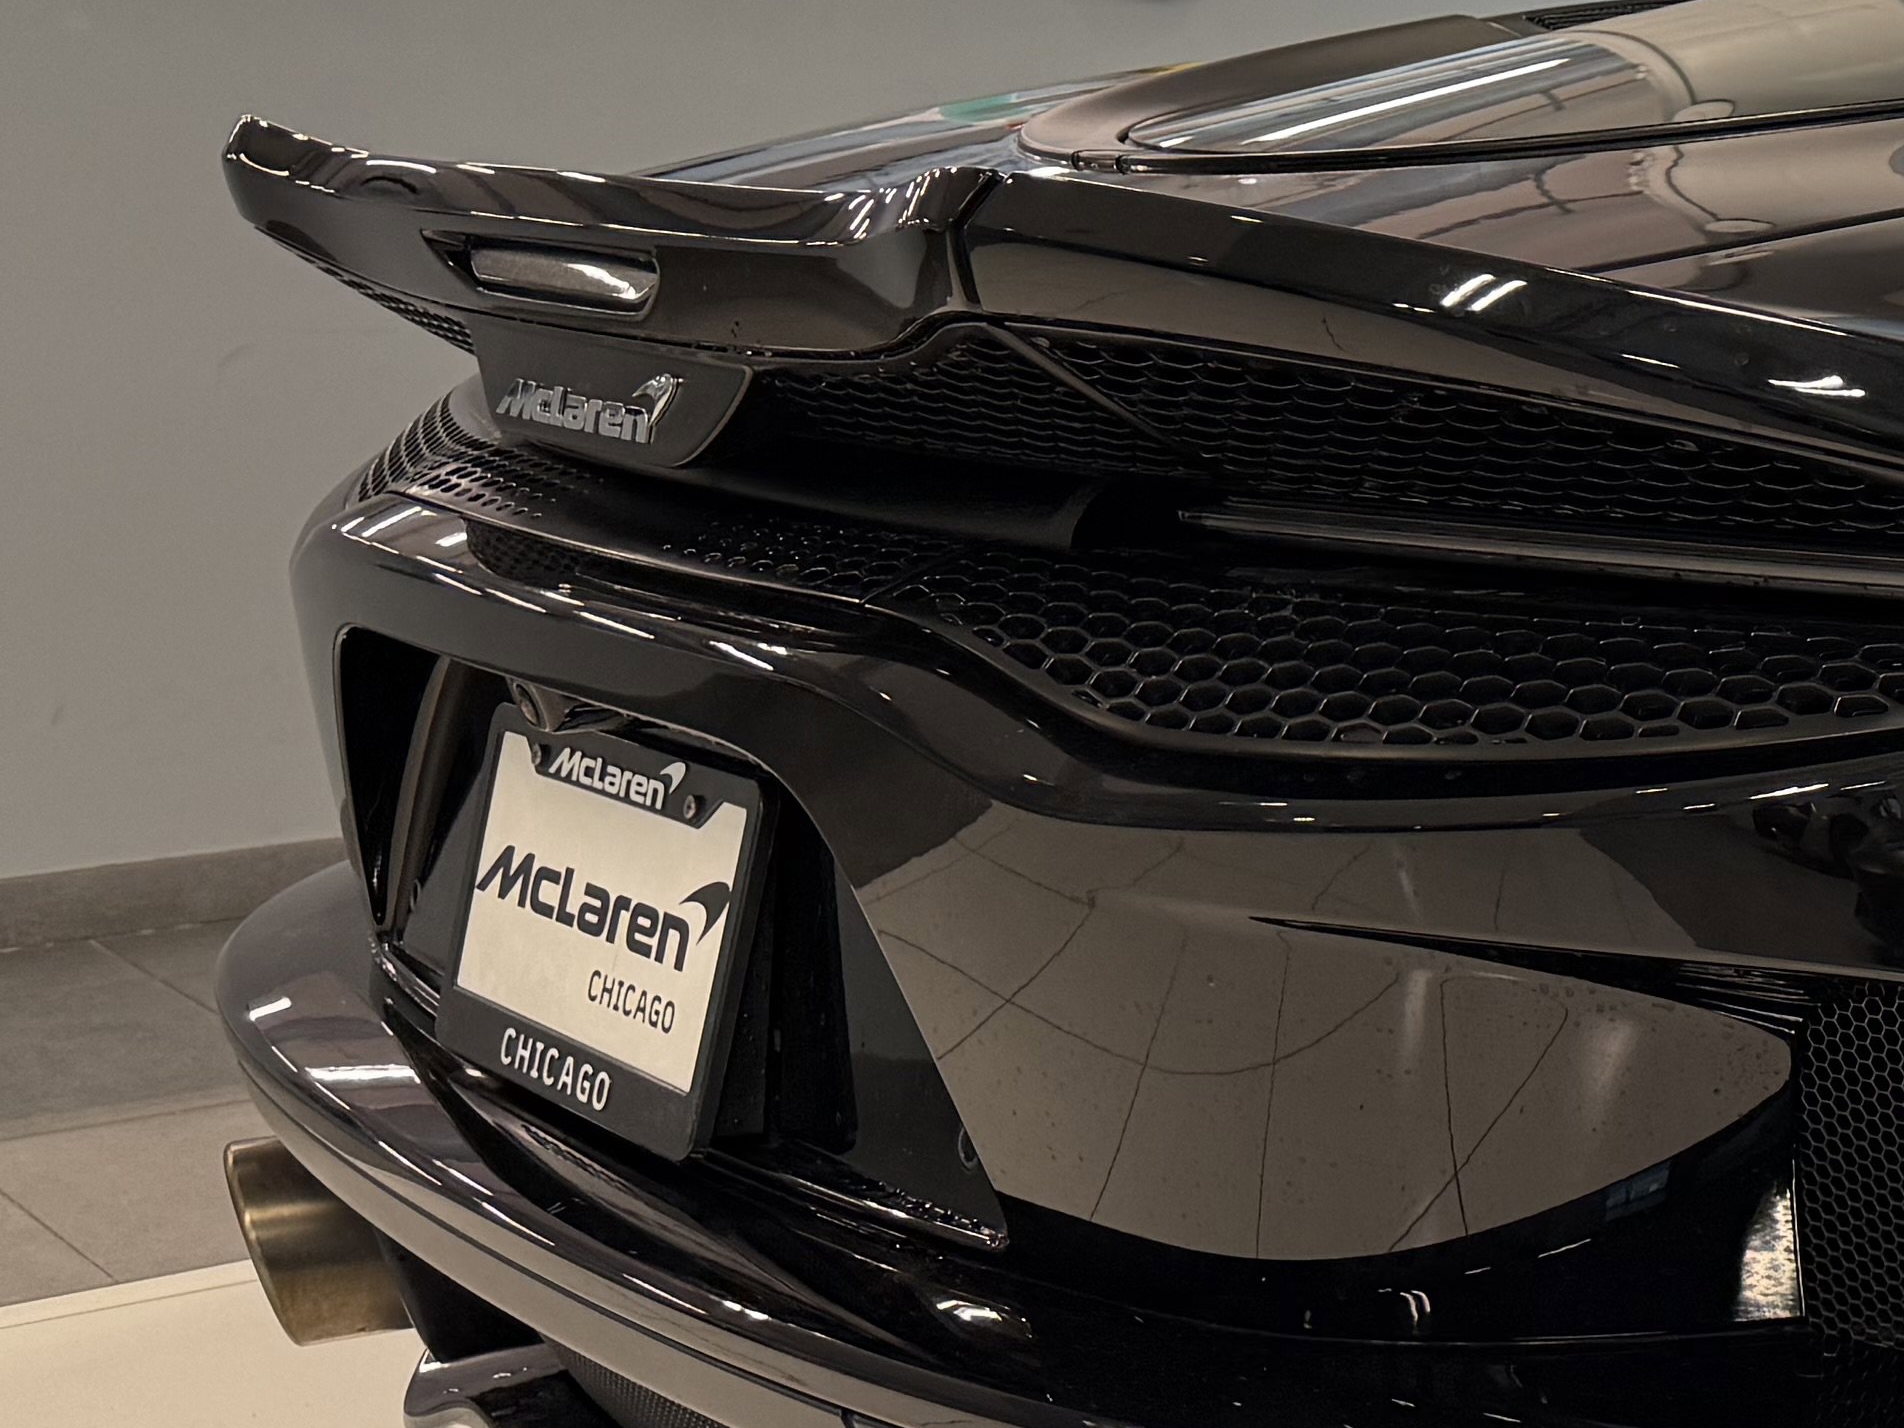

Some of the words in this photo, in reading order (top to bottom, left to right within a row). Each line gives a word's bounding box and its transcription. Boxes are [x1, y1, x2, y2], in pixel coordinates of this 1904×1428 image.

[495, 378, 651, 444] McLaren
[548, 746, 666, 810] McLaren
[475, 844, 690, 972] McLaren
[587, 969, 676, 1034] CHICAGO
[500, 1027, 611, 1112] CHICAGO
